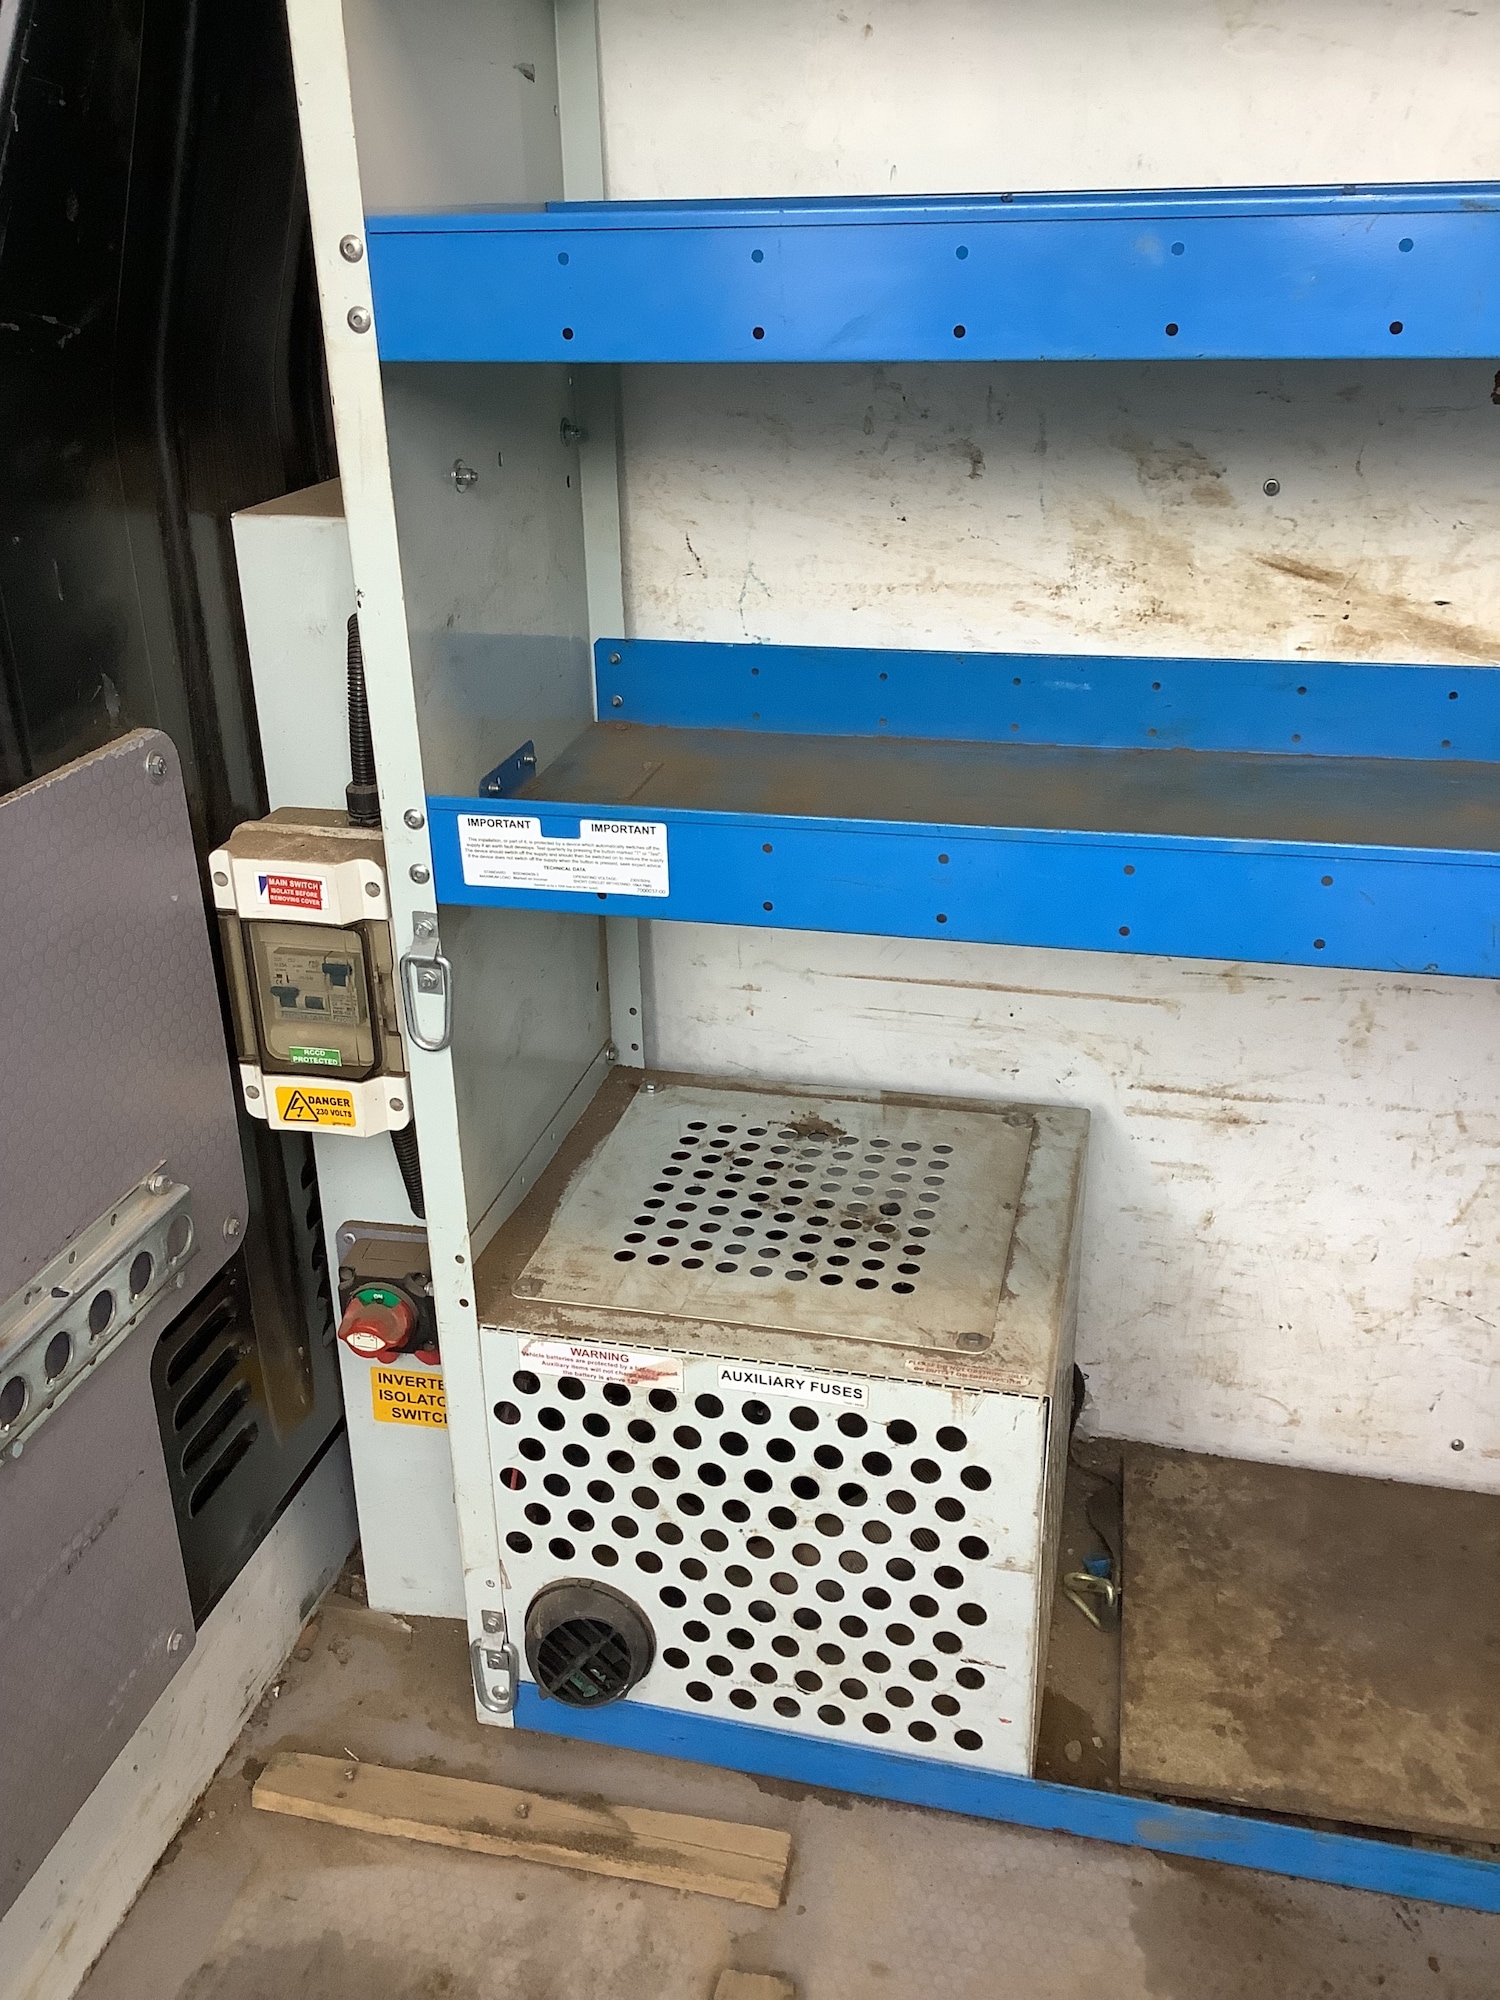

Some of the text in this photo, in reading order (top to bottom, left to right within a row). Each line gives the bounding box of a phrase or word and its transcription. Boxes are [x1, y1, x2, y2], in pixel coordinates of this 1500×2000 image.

[468, 818, 530, 829] IMPORTANT
[591, 824, 656, 835] IMPORTANT
[268, 878, 318, 890] MAIN SWITCH
[293, 1056, 338, 1065] PROTECTED
[308, 1096, 350, 1107] DANGER
[330, 1109, 352, 1118] VOLTS
[521, 1350, 544, 1358] Vehicle
[546, 1353, 574, 1362] batteries
[587, 1359, 618, 1368] protected
[570, 1347, 629, 1363] WARNING
[542, 1360, 569, 1369] Auxiliary
[378, 1372, 444, 1390] INVERTE
[575, 1371, 596, 1380] battery
[810, 1381, 863, 1399] FUSES
